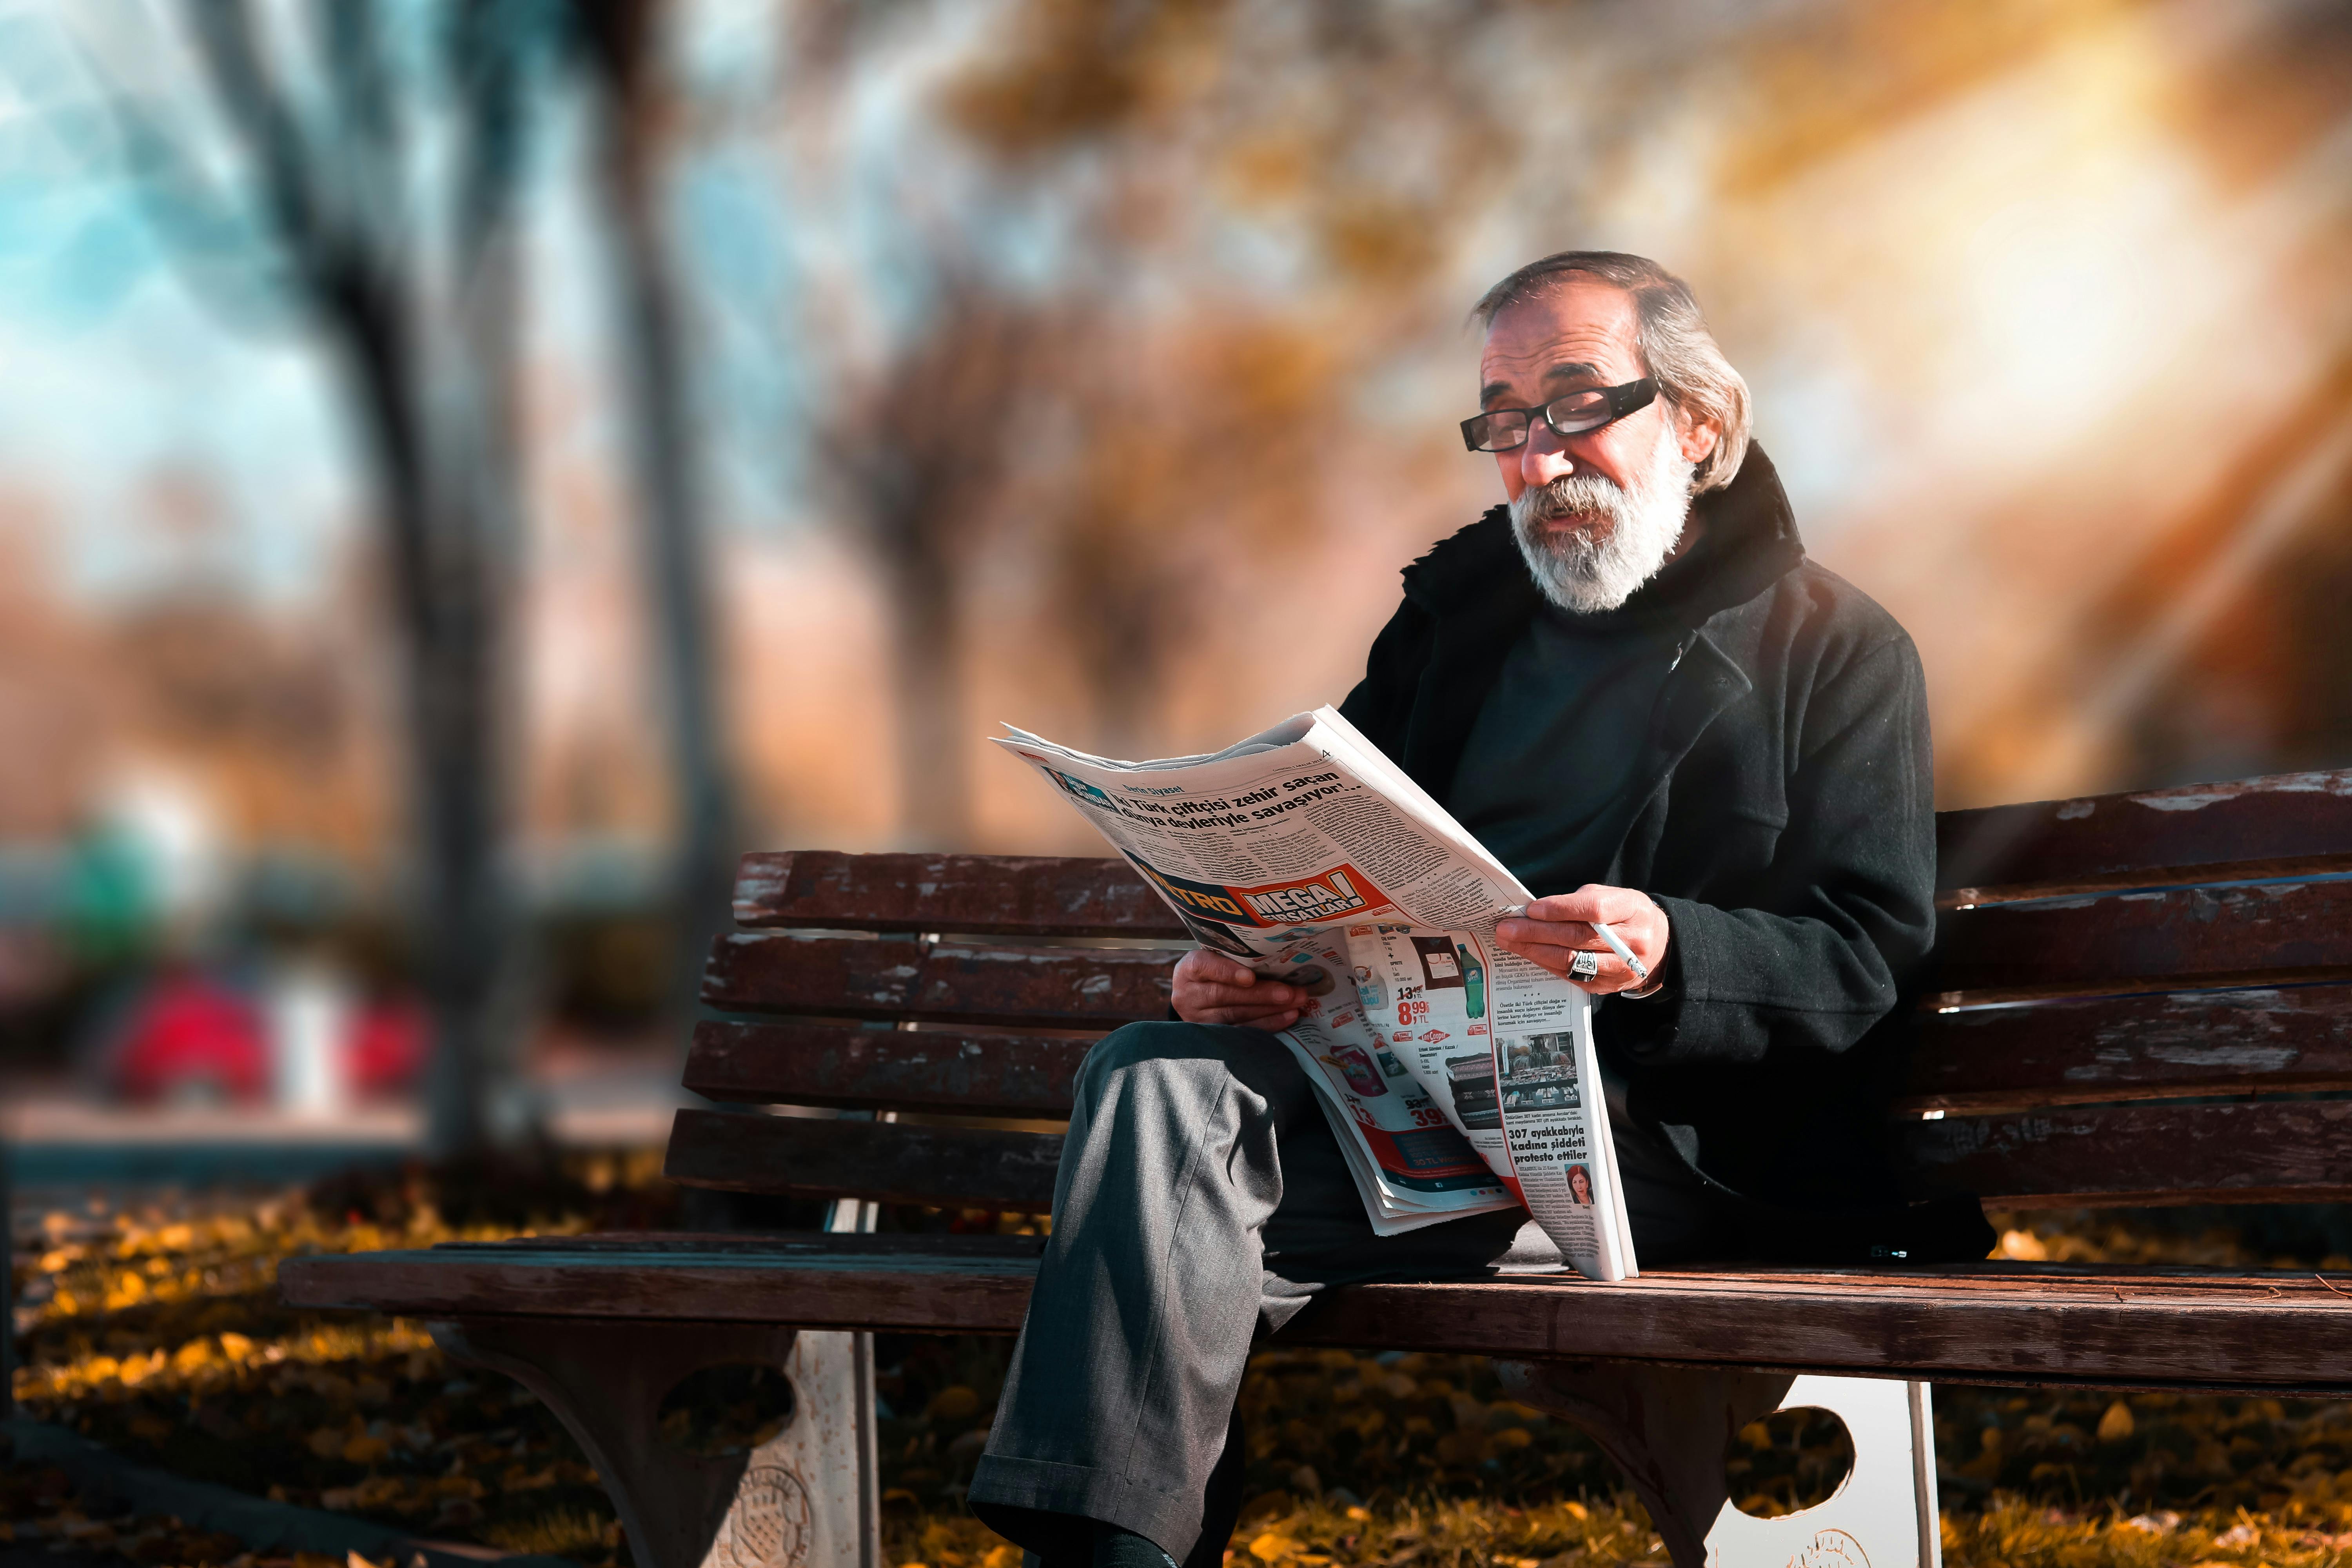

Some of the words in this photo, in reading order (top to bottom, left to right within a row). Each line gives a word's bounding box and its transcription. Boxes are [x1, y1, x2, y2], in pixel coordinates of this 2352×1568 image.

[1322, 750, 1331, 758] 4
[1122, 784, 1149, 794] Derin
[1147, 785, 1185, 797] Siyaset
[1129, 799, 1172, 815] Türk
[1170, 798, 1232, 818] çiftçisi
[1231, 786, 1279, 808] zehir
[1282, 771, 1340, 792] saçan
[1121, 807, 1168, 827] dünya
[1167, 812, 1250, 829] devleriyle
[1321, 822, 1339, 832] bilimsel
[1348, 824, 1367, 833] prensibi
[1343, 838, 1363, 849] olmayan
[1350, 838, 1385, 856] yurttaşlarımızın
[1366, 844, 1393, 858] yurttaşların
[1353, 849, 1374, 860] ilaçlanan
[1361, 857, 1376, 866] altında
[1370, 866, 1389, 876] koruma
[1388, 858, 1403, 868] ürünü
[1378, 858, 1395, 868] bayiler
[1387, 862, 1407, 873] maddesi
[1407, 853, 1424, 863] glifosat
[1388, 869, 1403, 878] birçok
[1413, 854, 1432, 864] koruma
[1385, 879, 1405, 888] reçetesiz
[1405, 871, 1420, 880] olarak
[1394, 866, 1418, 880] belirlemesi
[1427, 873, 1451, 887] Ankara'daki
[1451, 866, 1466, 874] mahke-
[1448, 869, 1470, 882] çıkmaması
[1388, 882, 1406, 891] biçimde
[1434, 881, 1457, 895] mücadeleyi
[1442, 887, 1465, 901] şirketlerin
[1465, 877, 1482, 888] başkan
[1448, 894, 1462, 902] zehirli
[1463, 882, 1483, 896] ürünlerin
[1453, 896, 1469, 905] yuman
[1469, 887, 1483, 898] dünya
[1509, 1128, 1528, 1139] 307
[1531, 1124, 1584, 1140] ayakkabıyla
[1510, 1140, 1548, 1151] kadına
[1551, 1136, 1586, 1151] şiddeti
[1514, 1152, 1554, 1165] protesto
[1557, 1149, 1587, 1160] ettiler
